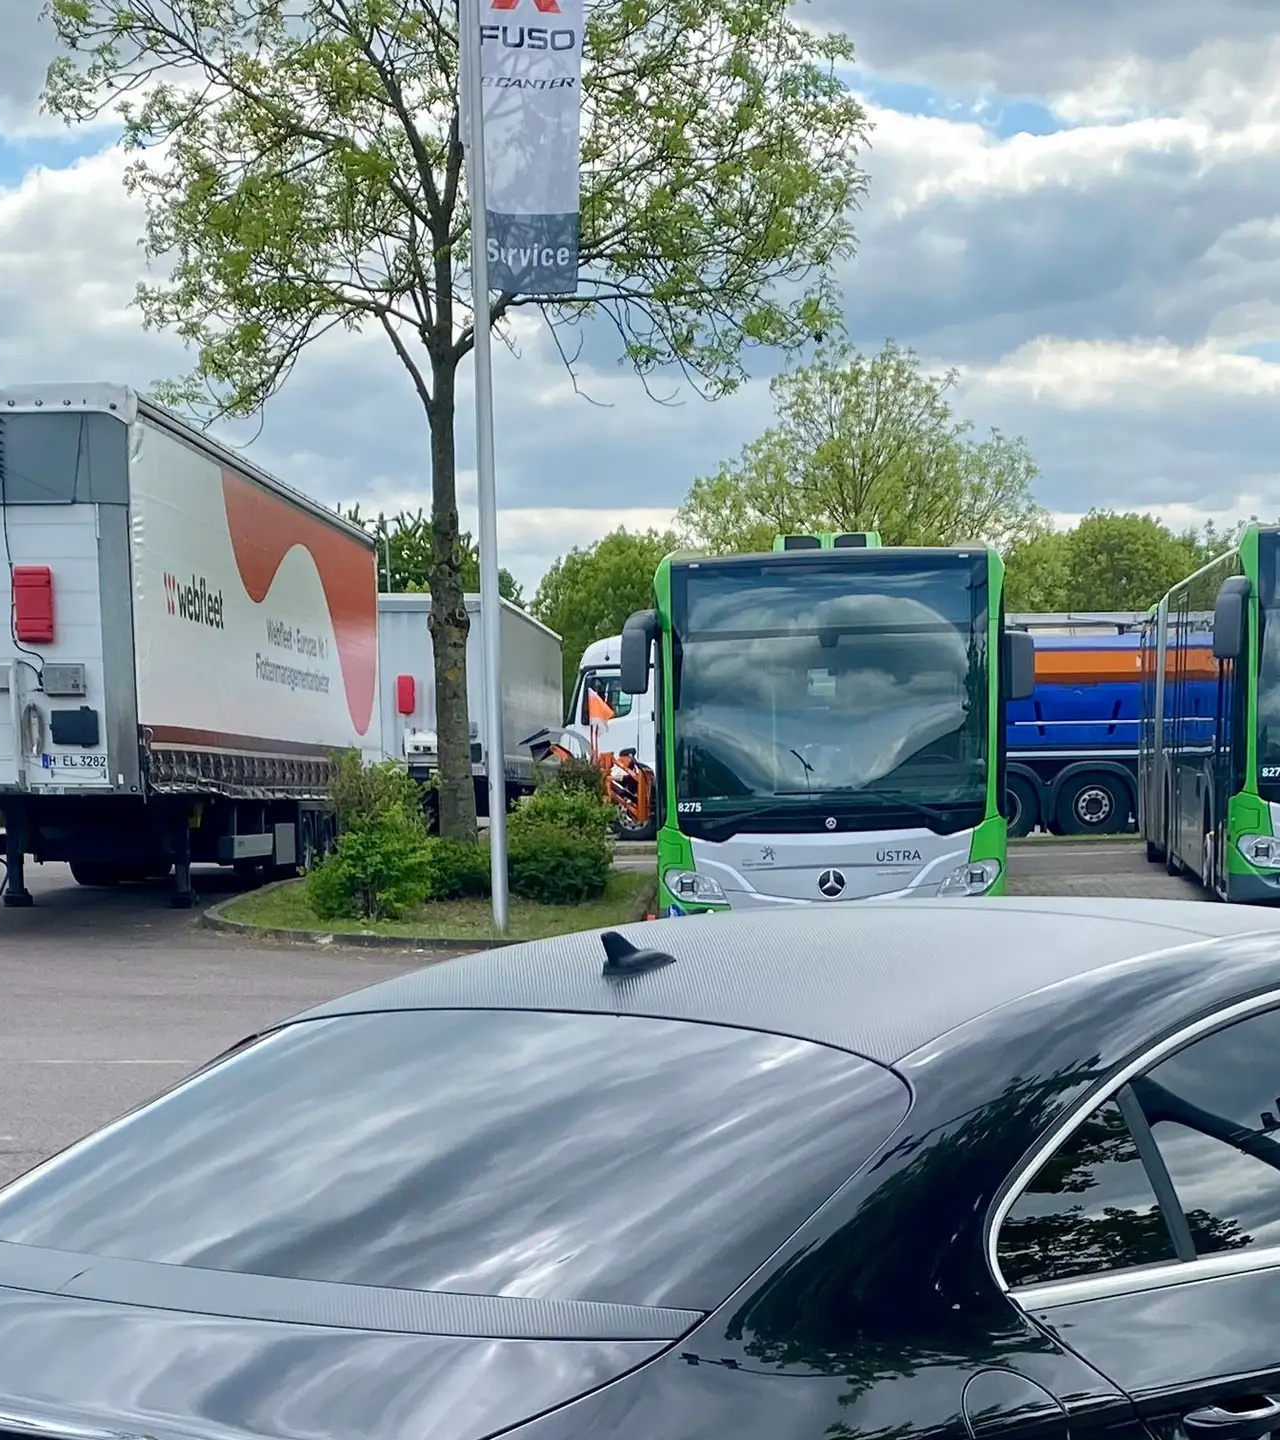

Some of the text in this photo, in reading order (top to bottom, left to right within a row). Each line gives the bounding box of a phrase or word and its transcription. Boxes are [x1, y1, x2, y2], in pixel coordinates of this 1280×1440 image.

[480, 26, 575, 51] FUSO
[177, 574, 224, 630] webfleet
[49, 755, 107, 767] H EL 3282
[677, 802, 702, 812] 8275
